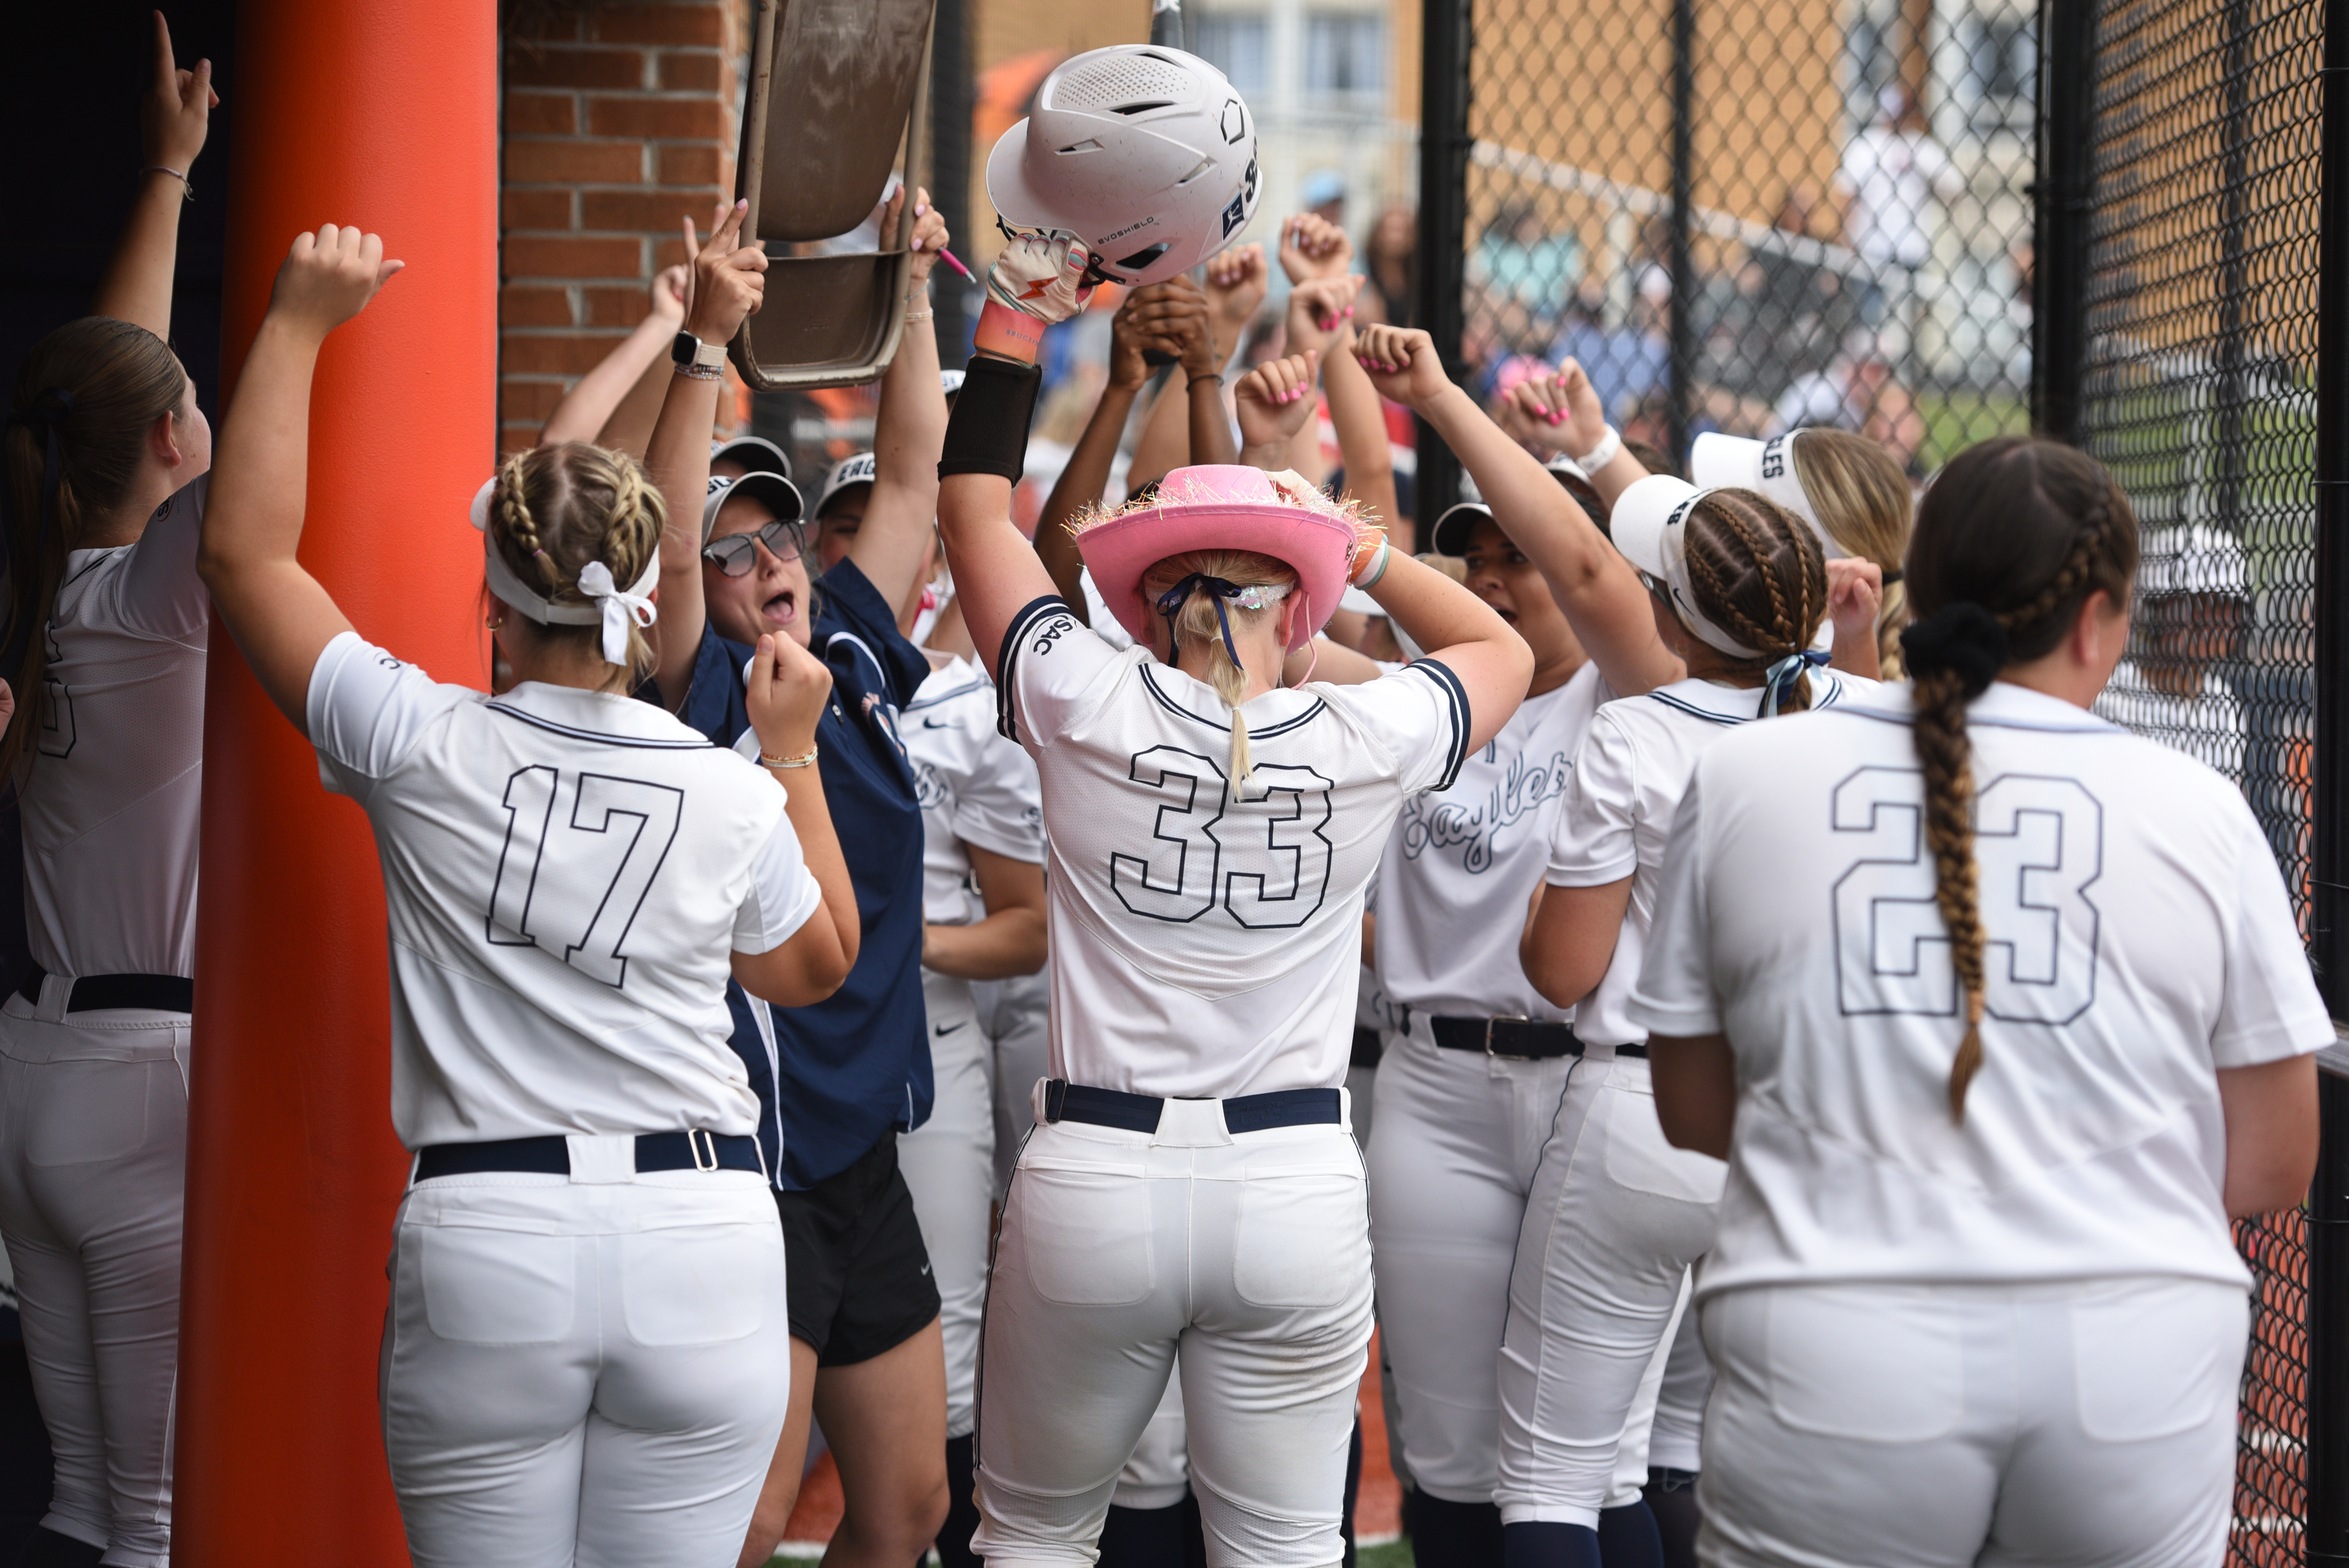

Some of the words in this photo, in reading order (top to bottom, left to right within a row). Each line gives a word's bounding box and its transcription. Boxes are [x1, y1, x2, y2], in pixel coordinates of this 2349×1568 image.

[1097, 216, 1154, 245] EVOSHIELD
[1033, 619, 1074, 656] SAC
[485, 763, 685, 990] 17
[1110, 744, 1335, 929] 33
[1831, 765, 2103, 1027] 23
